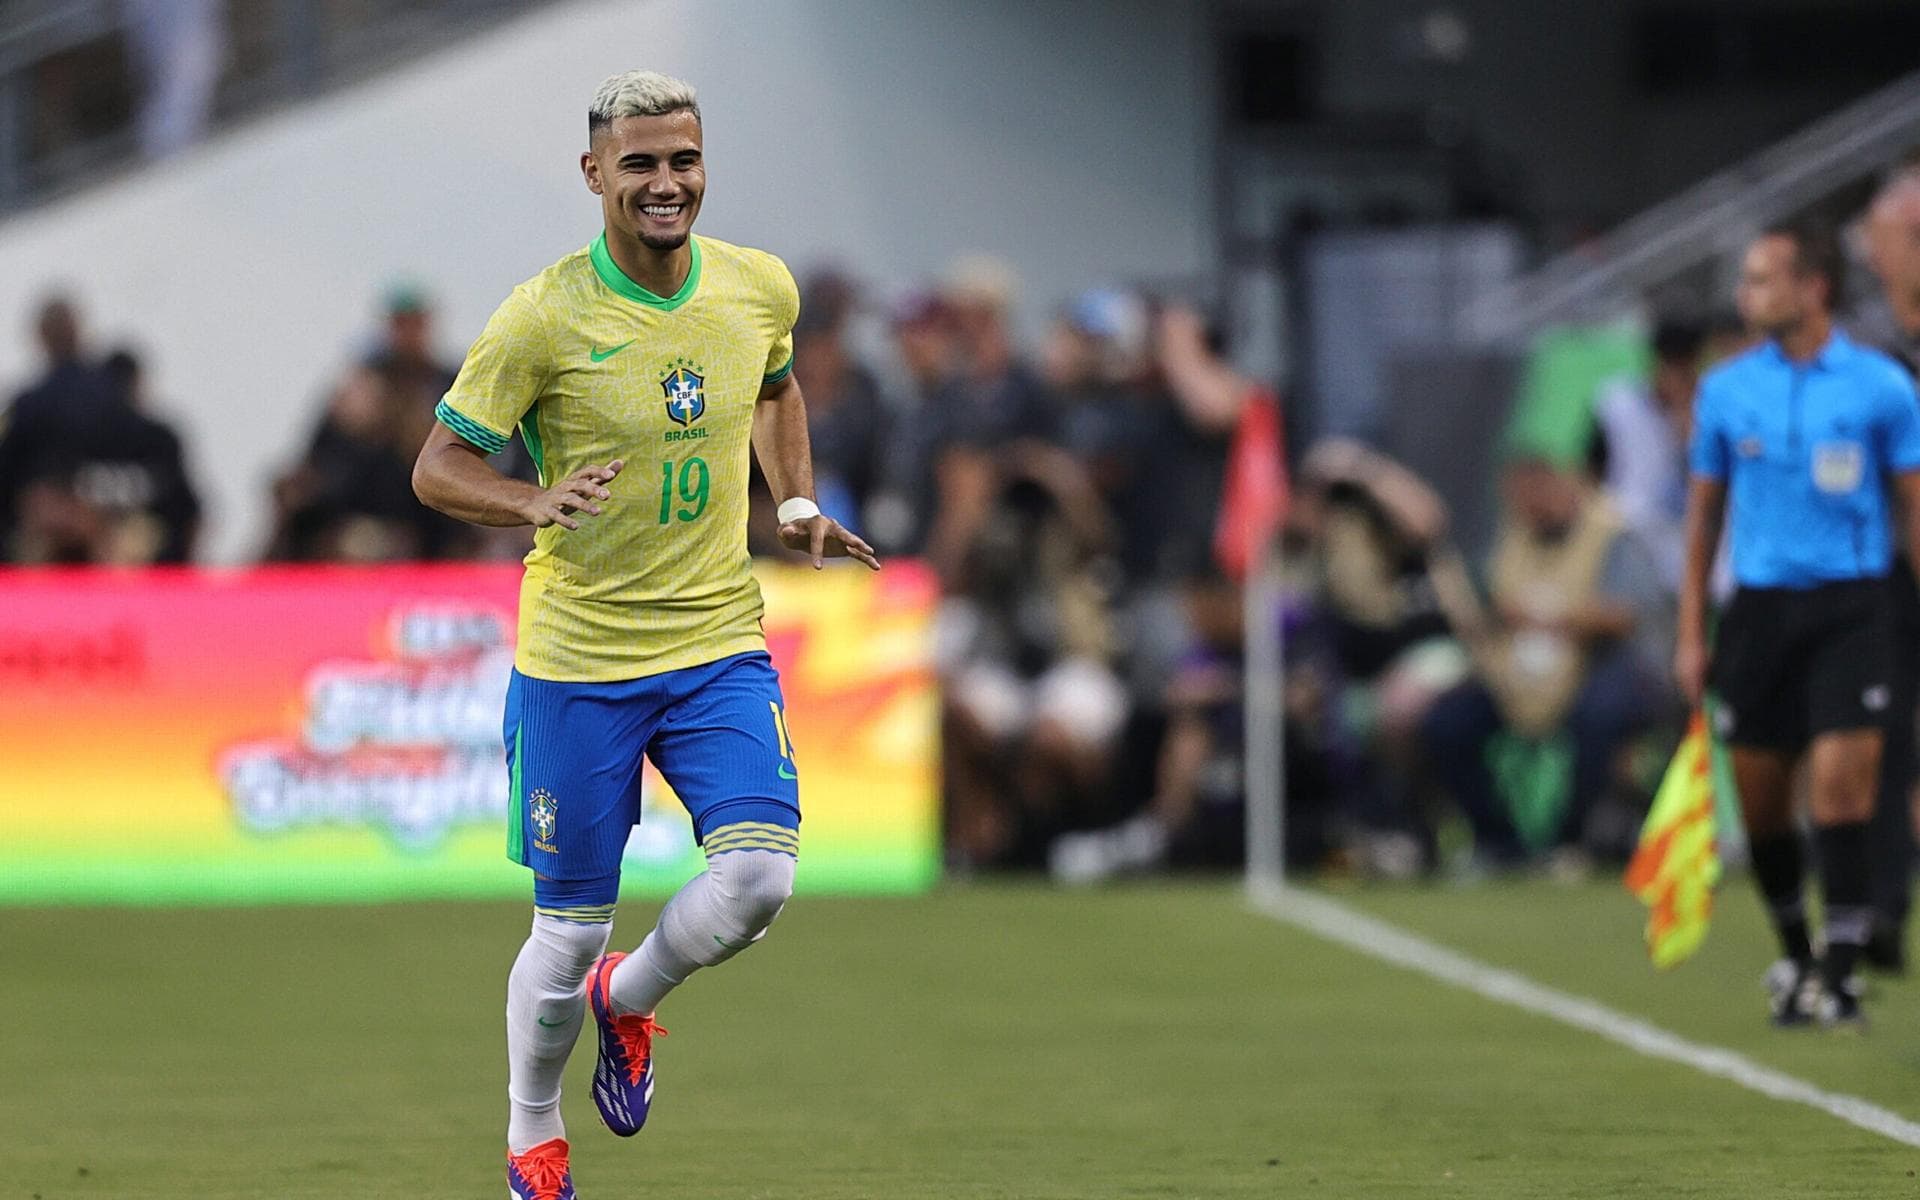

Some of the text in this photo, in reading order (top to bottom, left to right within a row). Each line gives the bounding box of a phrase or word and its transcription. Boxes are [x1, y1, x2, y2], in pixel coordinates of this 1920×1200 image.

[677, 392, 692, 400] CBF
[664, 428, 709, 442] BRASIL
[659, 457, 710, 525] 19
[769, 701, 795, 764] 1
